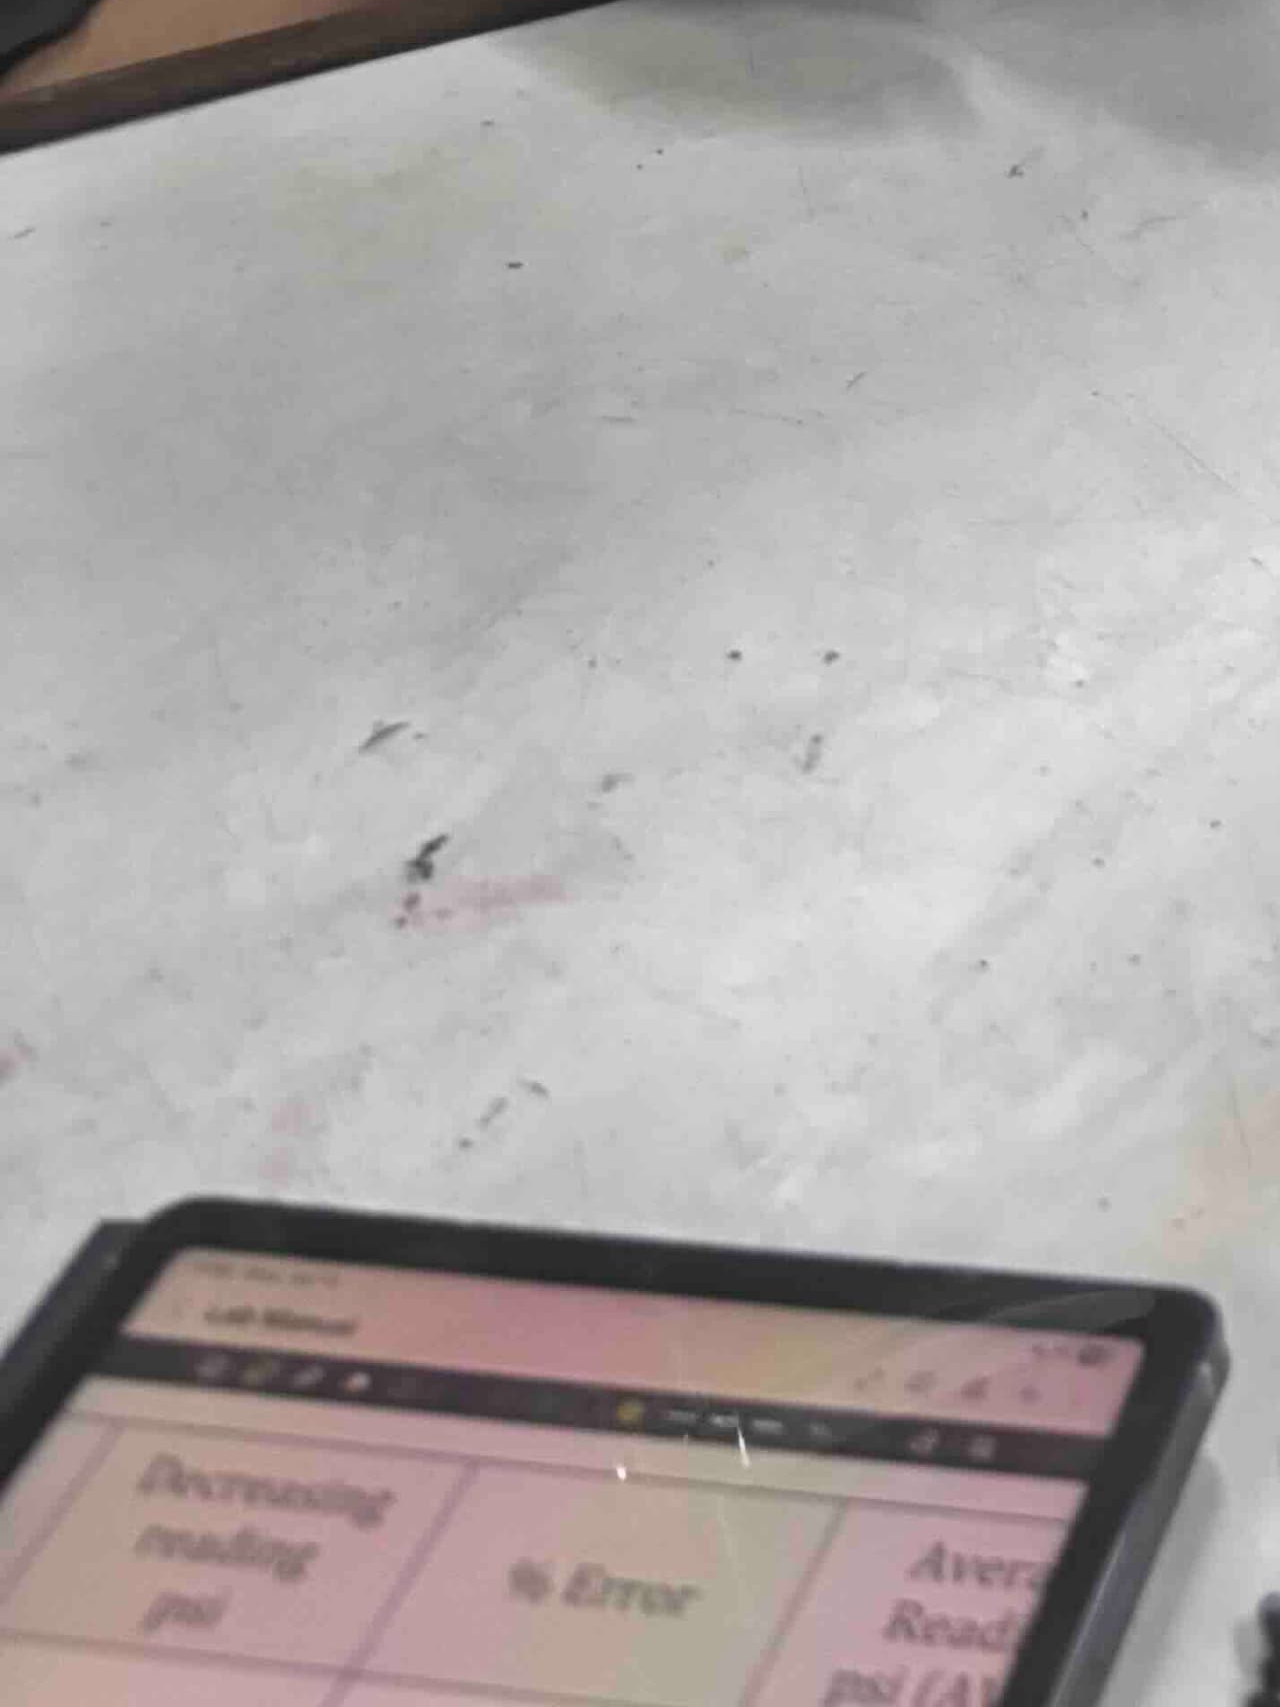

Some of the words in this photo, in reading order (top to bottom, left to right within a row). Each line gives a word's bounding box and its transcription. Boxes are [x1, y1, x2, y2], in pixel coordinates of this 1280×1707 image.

[136, 1453, 396, 1529] Decreasing
[133, 1523, 321, 1581] reading
[140, 1589, 234, 1633] psi
[508, 1556, 553, 1605] %
[561, 1561, 697, 1617] Error
